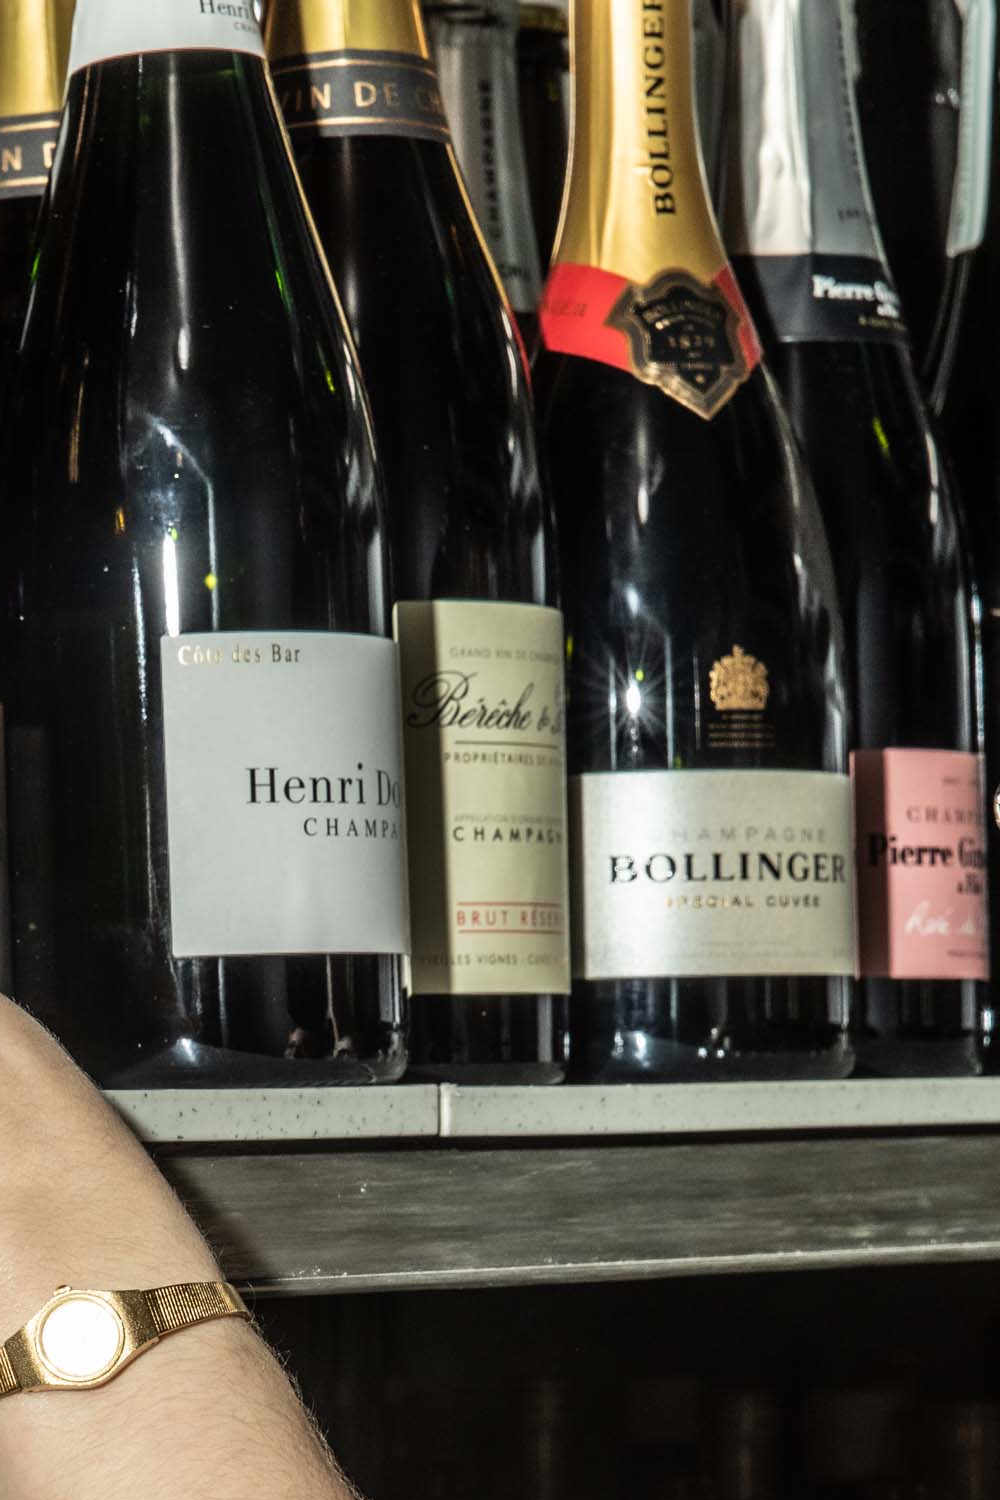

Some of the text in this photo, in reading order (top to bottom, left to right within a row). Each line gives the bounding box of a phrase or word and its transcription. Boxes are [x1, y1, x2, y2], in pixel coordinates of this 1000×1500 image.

[353, 80, 401, 108] DE
[177, 643, 301, 666] Côte des Bar
[246, 761, 367, 805] Henri
[867, 833, 952, 867] Pierre
[608, 852, 847, 884] BOLLINGER
[456, 910, 508, 927] BRUT
